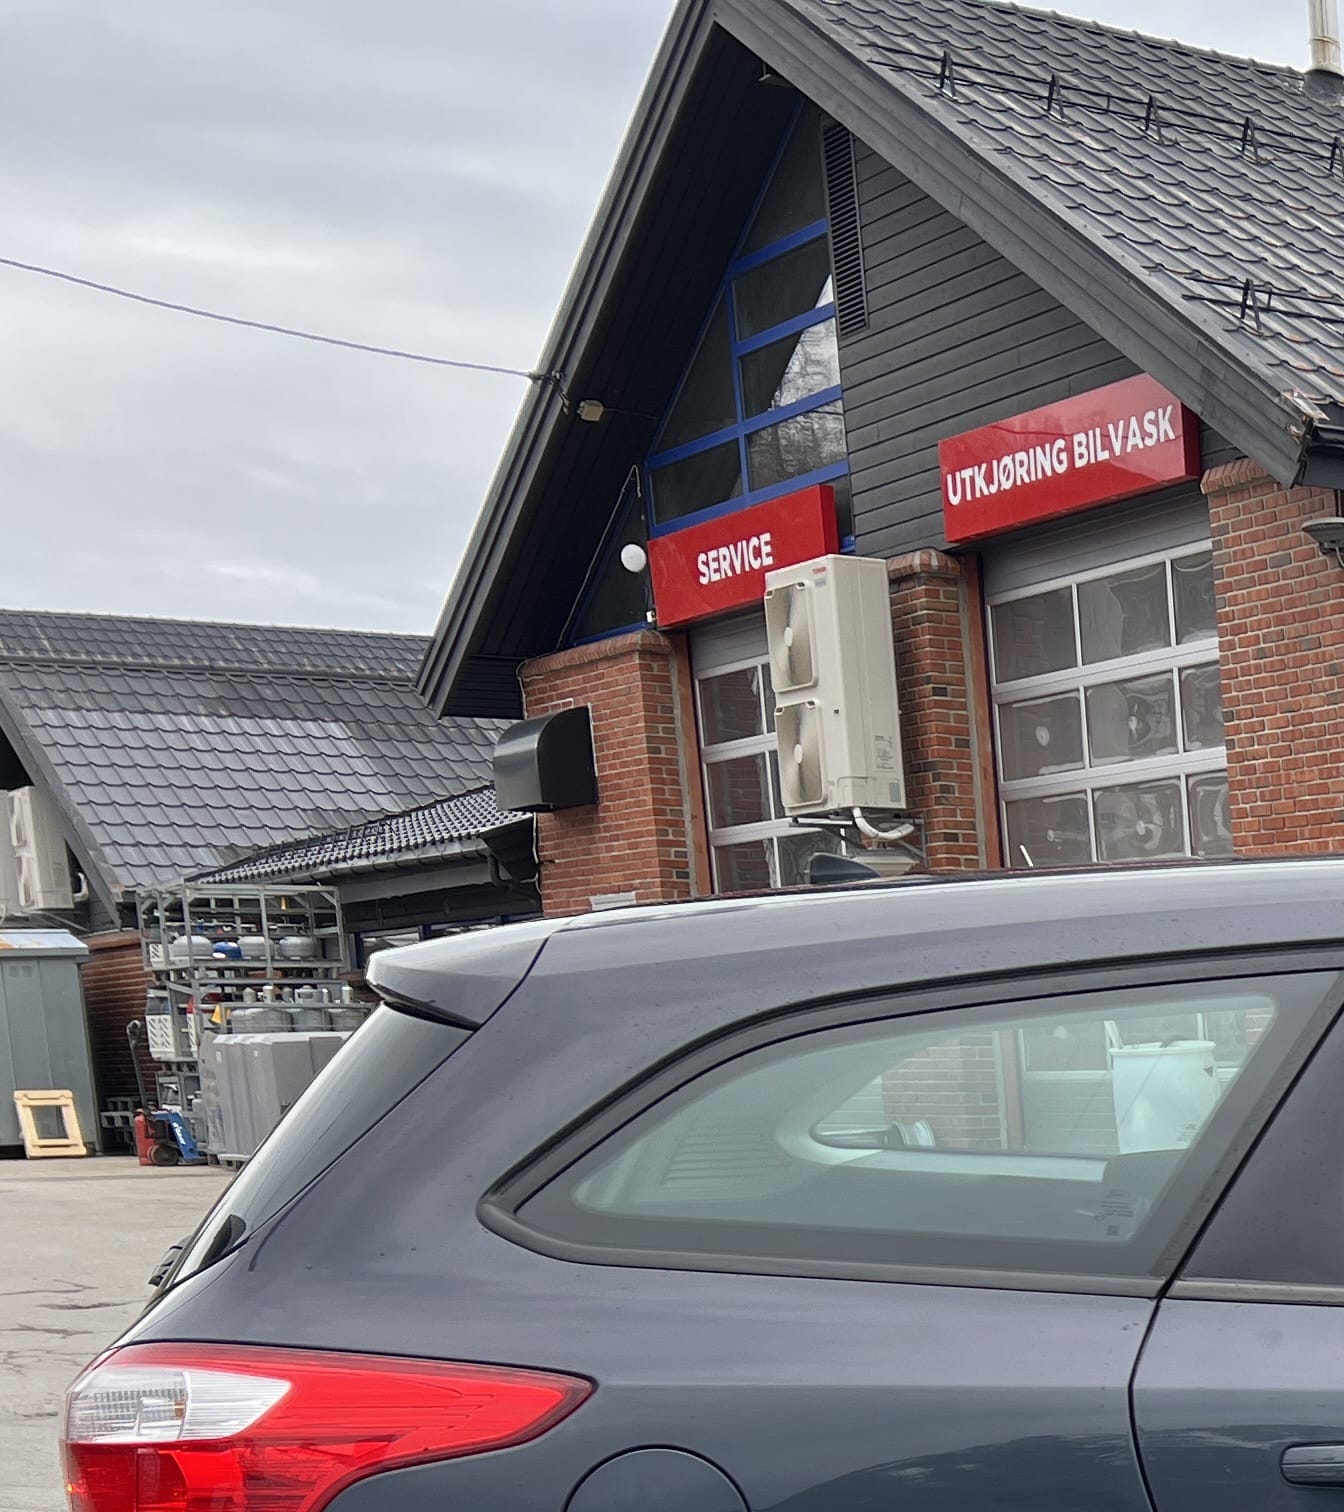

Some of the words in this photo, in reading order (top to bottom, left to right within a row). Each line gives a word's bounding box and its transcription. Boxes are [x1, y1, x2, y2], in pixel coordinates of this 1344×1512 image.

[946, 438, 1068, 506] UTKJØRING
[1073, 405, 1176, 468] BILVASK
[697, 532, 774, 585] SERVICE
